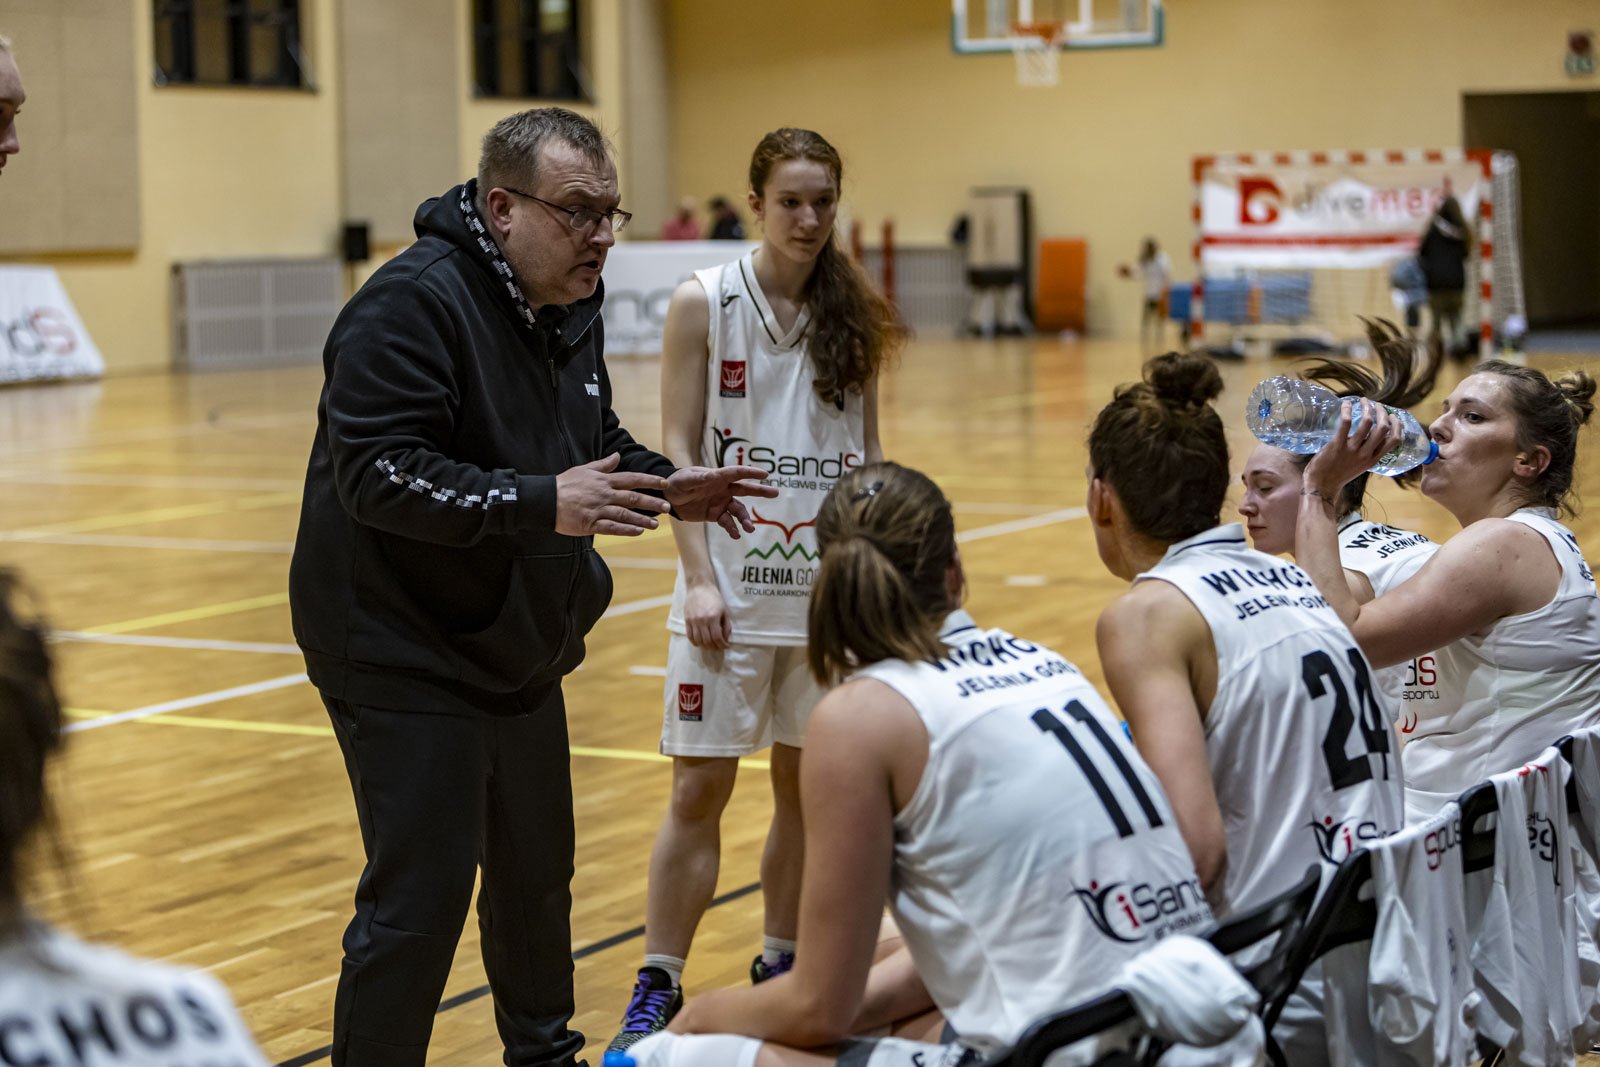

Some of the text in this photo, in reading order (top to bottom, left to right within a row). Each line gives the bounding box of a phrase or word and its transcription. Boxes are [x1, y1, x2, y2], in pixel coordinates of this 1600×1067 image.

[1376, 537, 1417, 559] JELENIA
[740, 565, 793, 585] JELENIA
[744, 587, 776, 597] STOLICA
[957, 671, 1035, 698] JELENIA
[1402, 690, 1440, 702] sportu
[1301, 647, 1390, 792] 24
[1029, 698, 1164, 839] 11
